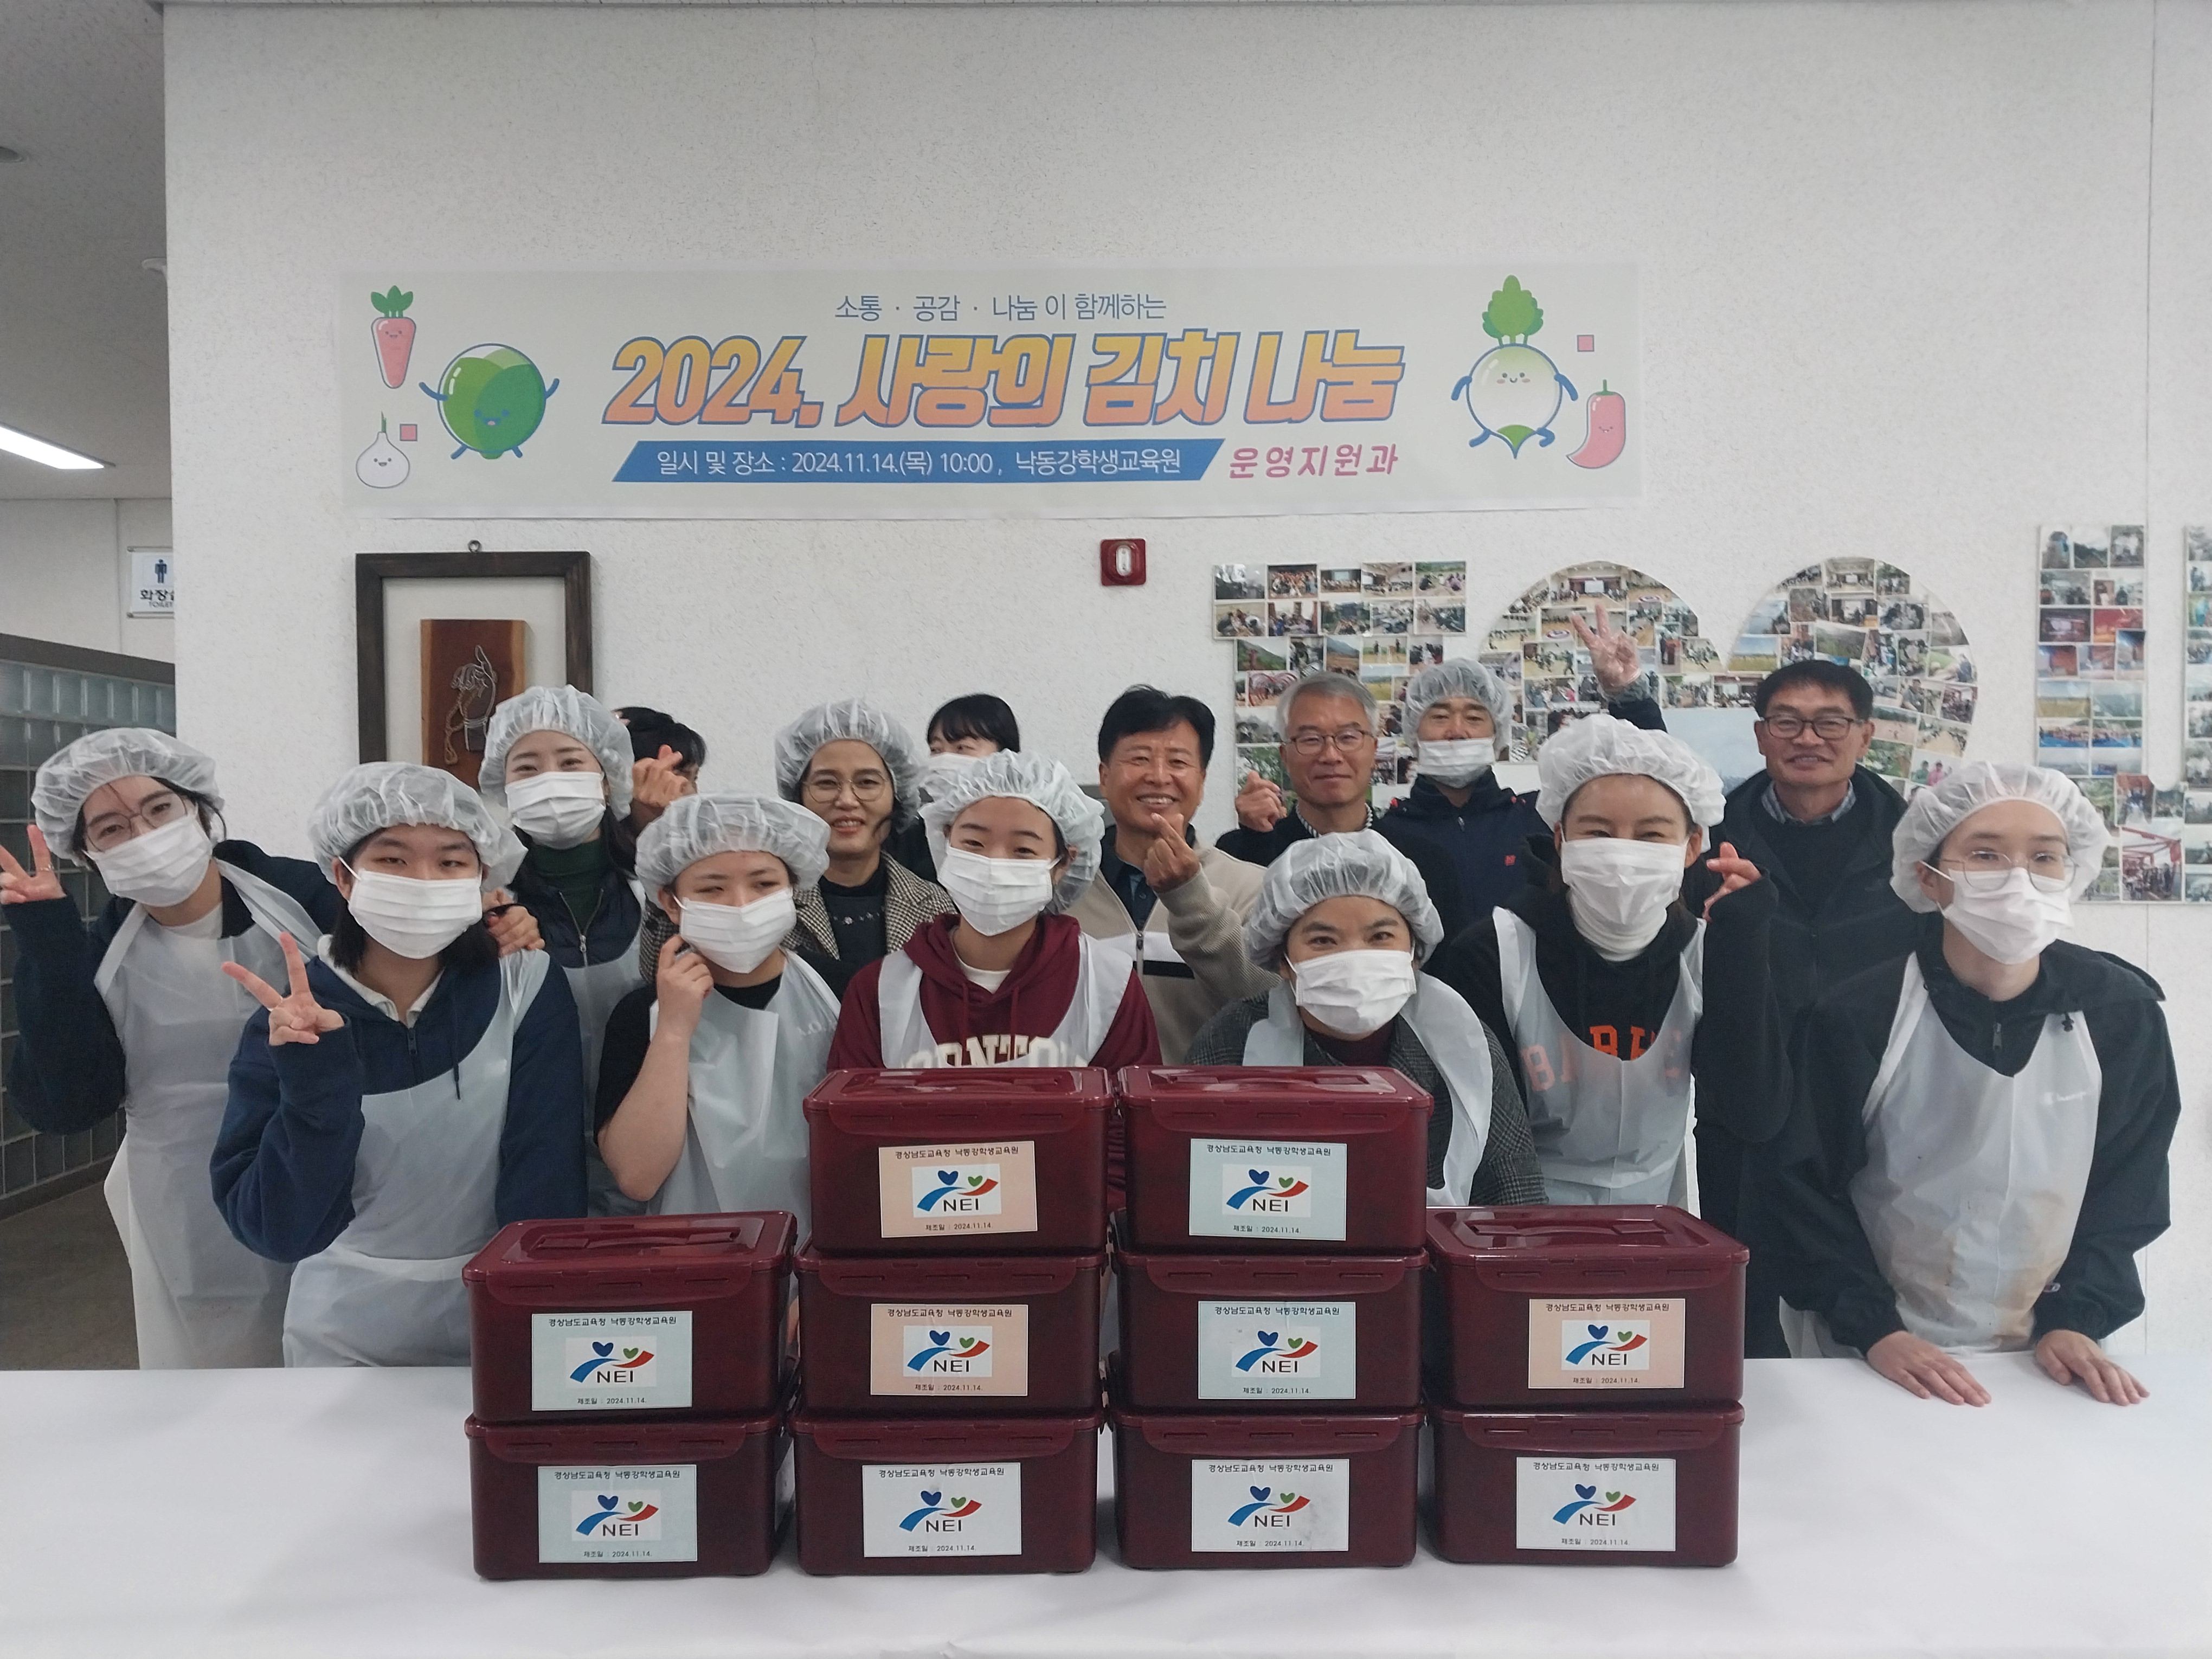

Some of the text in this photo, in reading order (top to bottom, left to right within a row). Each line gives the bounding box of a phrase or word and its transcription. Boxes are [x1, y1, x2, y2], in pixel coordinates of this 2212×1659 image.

[835, 295, 882, 321] 소통
[913, 295, 960, 321] 공감
[993, 295, 1038, 321] 나눔
[1075, 293, 1166, 319] 함께하는
[602, 329, 1405, 428] 2024. 사랑의 김치 나눔
[658, 451, 697, 474] 일시
[706, 451, 725, 474] 및
[732, 451, 775, 475] 장소
[792, 451, 932, 475] 2024.11.14.(목)
[1017, 449, 1180, 475] 낙동강학생교육원
[1231, 445, 1397, 478] 운영지원과
[895, 1146, 1019, 1160] 경상남도교육청 낙동강학생교육원
[1207, 1144, 1331, 1156] 경상남도교육청 낙동강학생교육원
[943, 1199, 979, 1212] NEI
[1253, 1199, 1288, 1212] NEI
[888, 1309, 1012, 1317] 경상남도교육청 낙동강학생교육원
[1214, 1307, 1340, 1316] 경상남도교육청 낙동강학생교육원
[1546, 1303, 1669, 1312] 경상남도교육청 낙동강학생교육원
[549, 1316, 677, 1327] 경상남도교육청 낙동강학생교육원
[1592, 1354, 1626, 1365] NEI
[934, 1360, 969, 1372] NEI
[1263, 1361, 1297, 1373] NEI
[597, 1371, 633, 1383] NEI
[879, 1467, 1004, 1478] 경상남도교육청 낙동강학생교육원
[1208, 1464, 1333, 1473] 경상남도교육청 낙동강학생교육원
[1533, 1462, 1659, 1471] 경상남도교육청 낙동강학생교육원
[554, 1470, 680, 1480] 경상남도교육청 낙동강학생교육원
[926, 1520, 961, 1532] NEI
[1255, 1515, 1289, 1527] NEI
[1580, 1514, 1615, 1526] NEI
[603, 1524, 638, 1536] NEI
